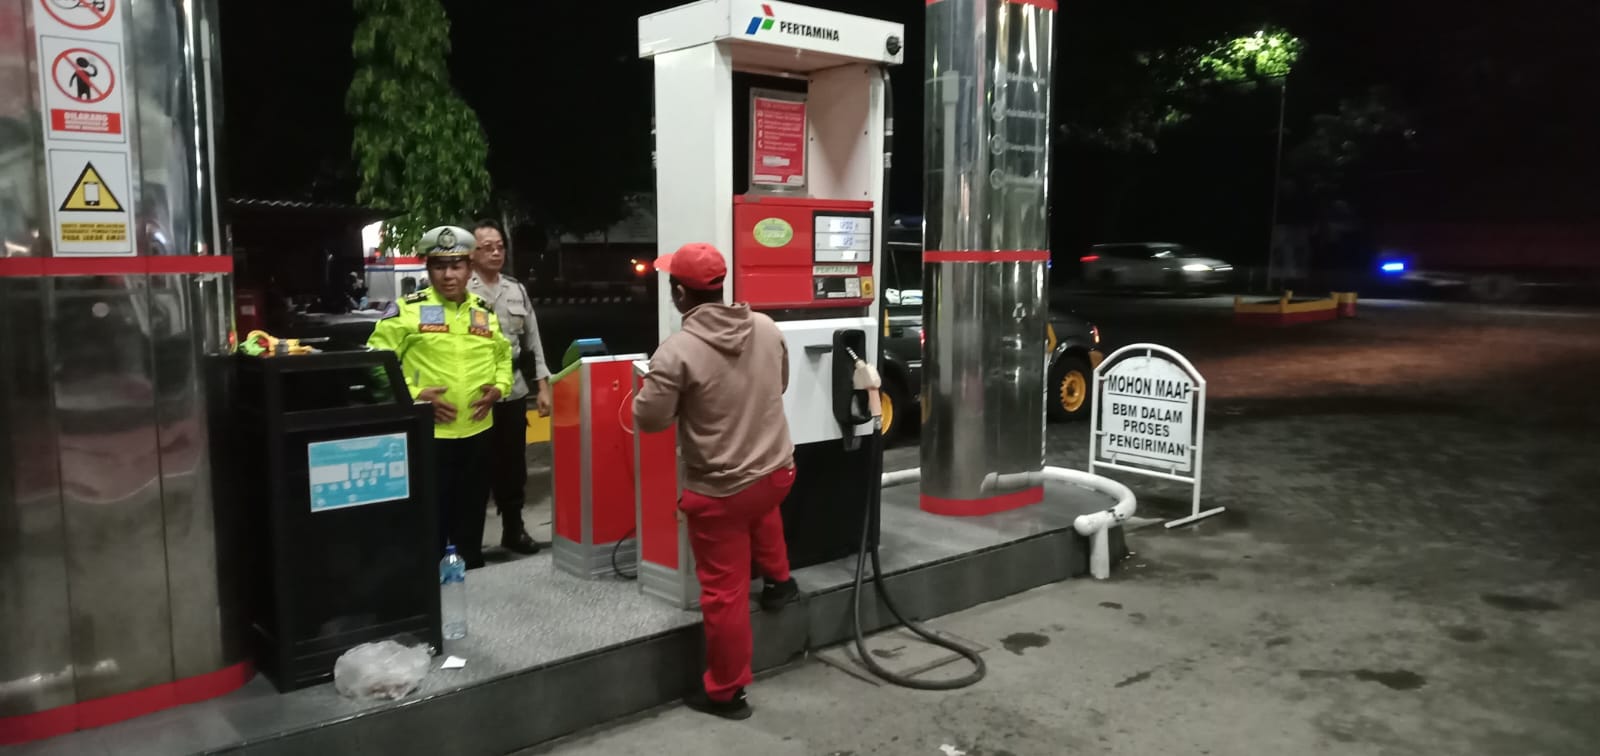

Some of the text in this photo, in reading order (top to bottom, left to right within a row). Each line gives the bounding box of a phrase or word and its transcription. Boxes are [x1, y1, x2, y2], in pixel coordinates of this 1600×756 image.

[780, 21, 840, 41] PERTAMINA
[1108, 374, 1190, 400] MOHON MAAF
[1112, 402, 1183, 423] BBM DALAM
[1123, 419, 1170, 437] PROSES
[1109, 433, 1185, 456] PENGIRIMAN
